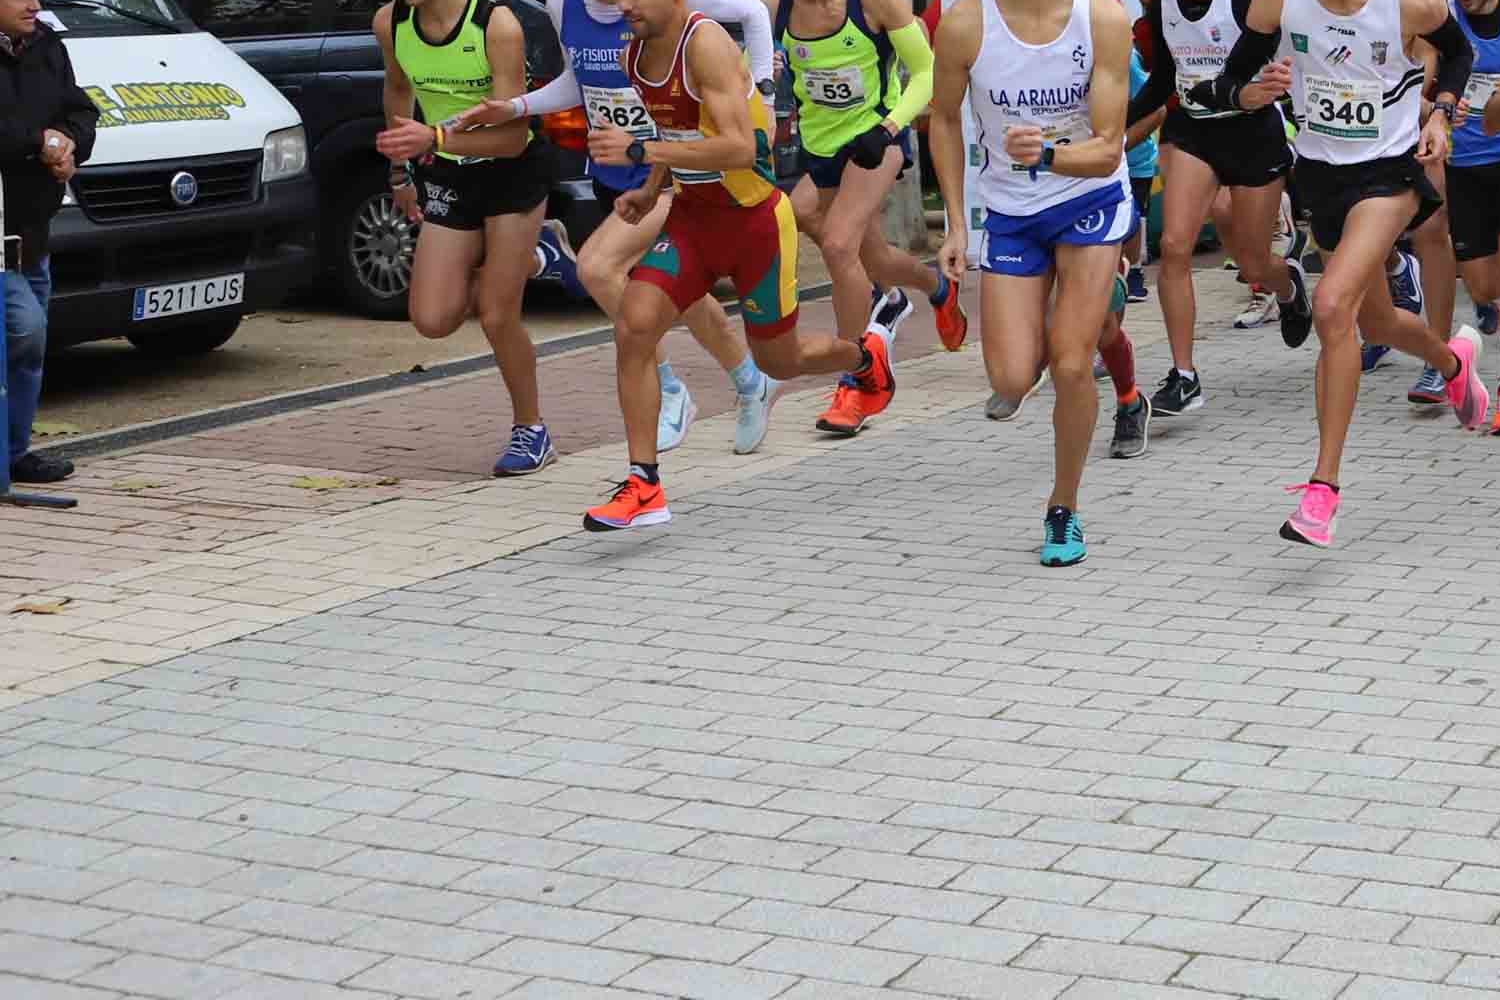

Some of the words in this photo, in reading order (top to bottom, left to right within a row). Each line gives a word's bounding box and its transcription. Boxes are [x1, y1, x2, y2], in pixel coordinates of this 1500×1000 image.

[583, 48, 625, 62] FISIOTE
[111, 82, 246, 108] ANTONIO
[823, 83, 852, 100] 53
[989, 89, 1010, 108] LA
[1017, 82, 1091, 107] ARMUÑA
[598, 105, 649, 127] 362
[1319, 98, 1375, 125] 340
[176, 183, 194, 195] FIAT
[149, 288, 196, 313] 5211
[204, 278, 240, 305] CJS
